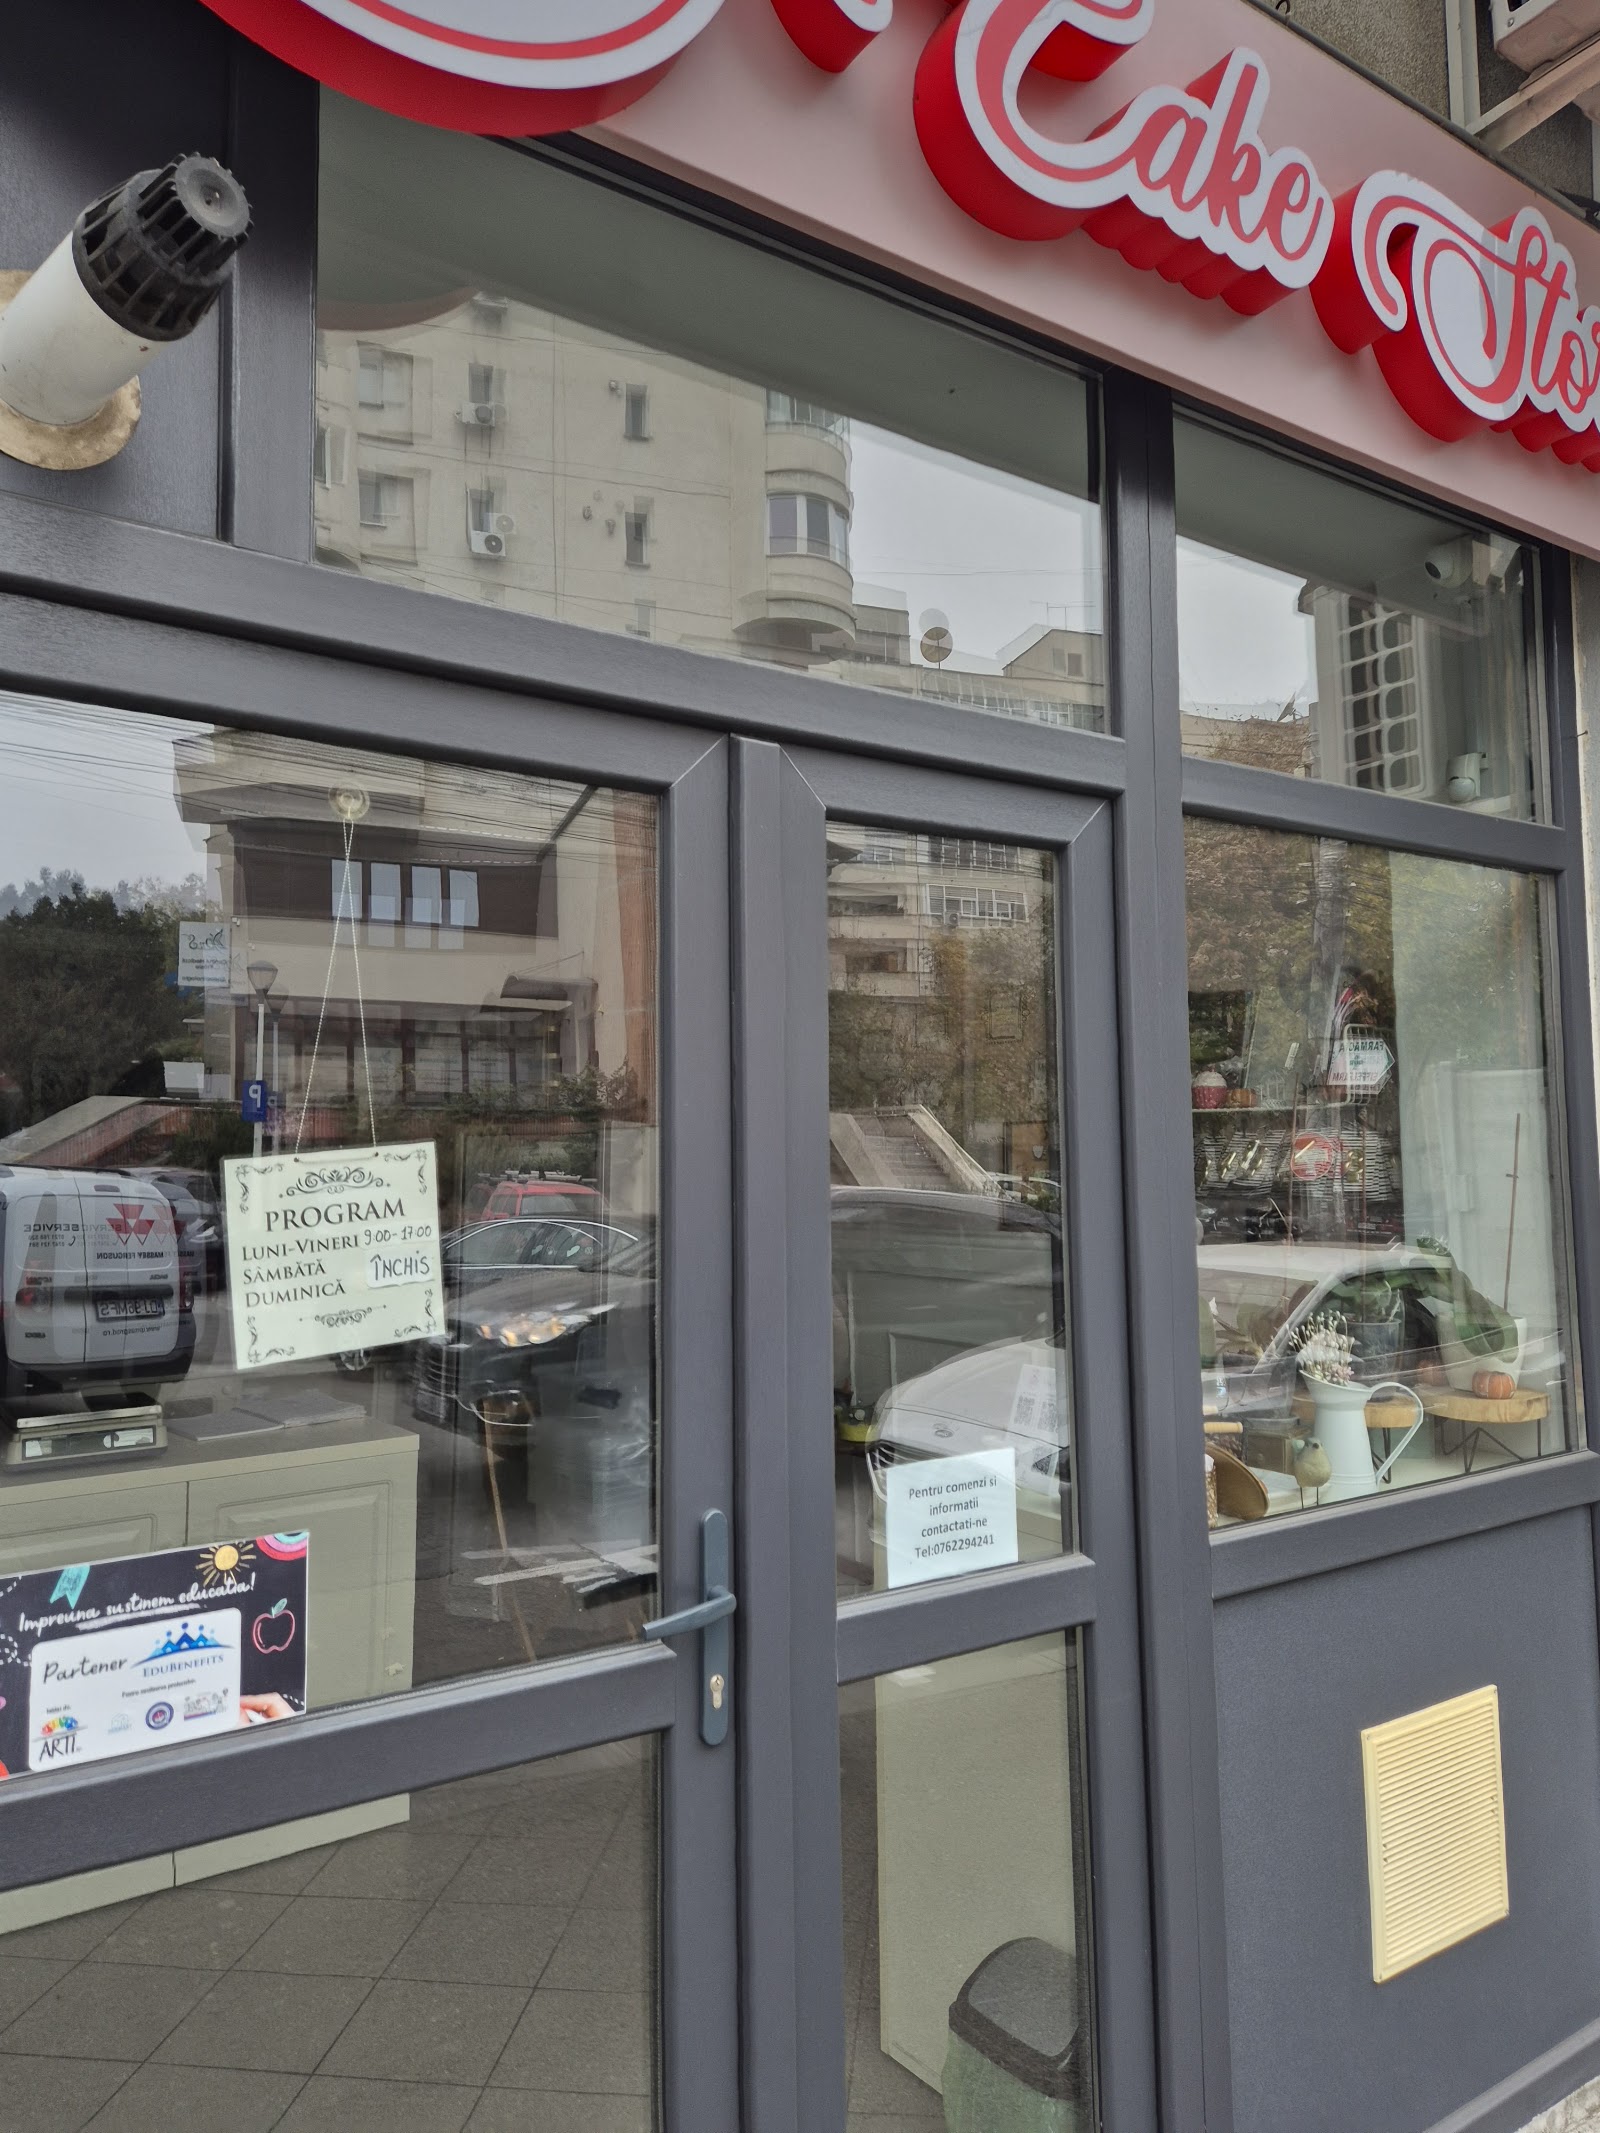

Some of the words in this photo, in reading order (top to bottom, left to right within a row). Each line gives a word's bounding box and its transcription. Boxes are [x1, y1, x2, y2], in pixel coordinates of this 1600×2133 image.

[956, 0, 1334, 287] Cake
[1352, 170, 1600, 432] Sto
[265, 1198, 406, 1232] PROGRAM
[242, 1235, 359, 1261] LUNI-VINERI
[243, 1258, 327, 1285] SÂMBĂTĂ
[245, 1279, 346, 1308] DUMINICĂ
[908, 1485, 943, 1499] Pentru
[945, 1477, 987, 1494] comenzi
[989, 1476, 997, 1487] si
[929, 1497, 979, 1516] informatii
[921, 1516, 988, 1538] contactati-ne
[914, 1533, 995, 1559] Tel:0762294241
[19, 1605, 101, 1638] Impreuna
[106, 1592, 175, 1616] sustinem
[178, 1571, 256, 1604] educatia!
[42, 1655, 129, 1685] Partener
